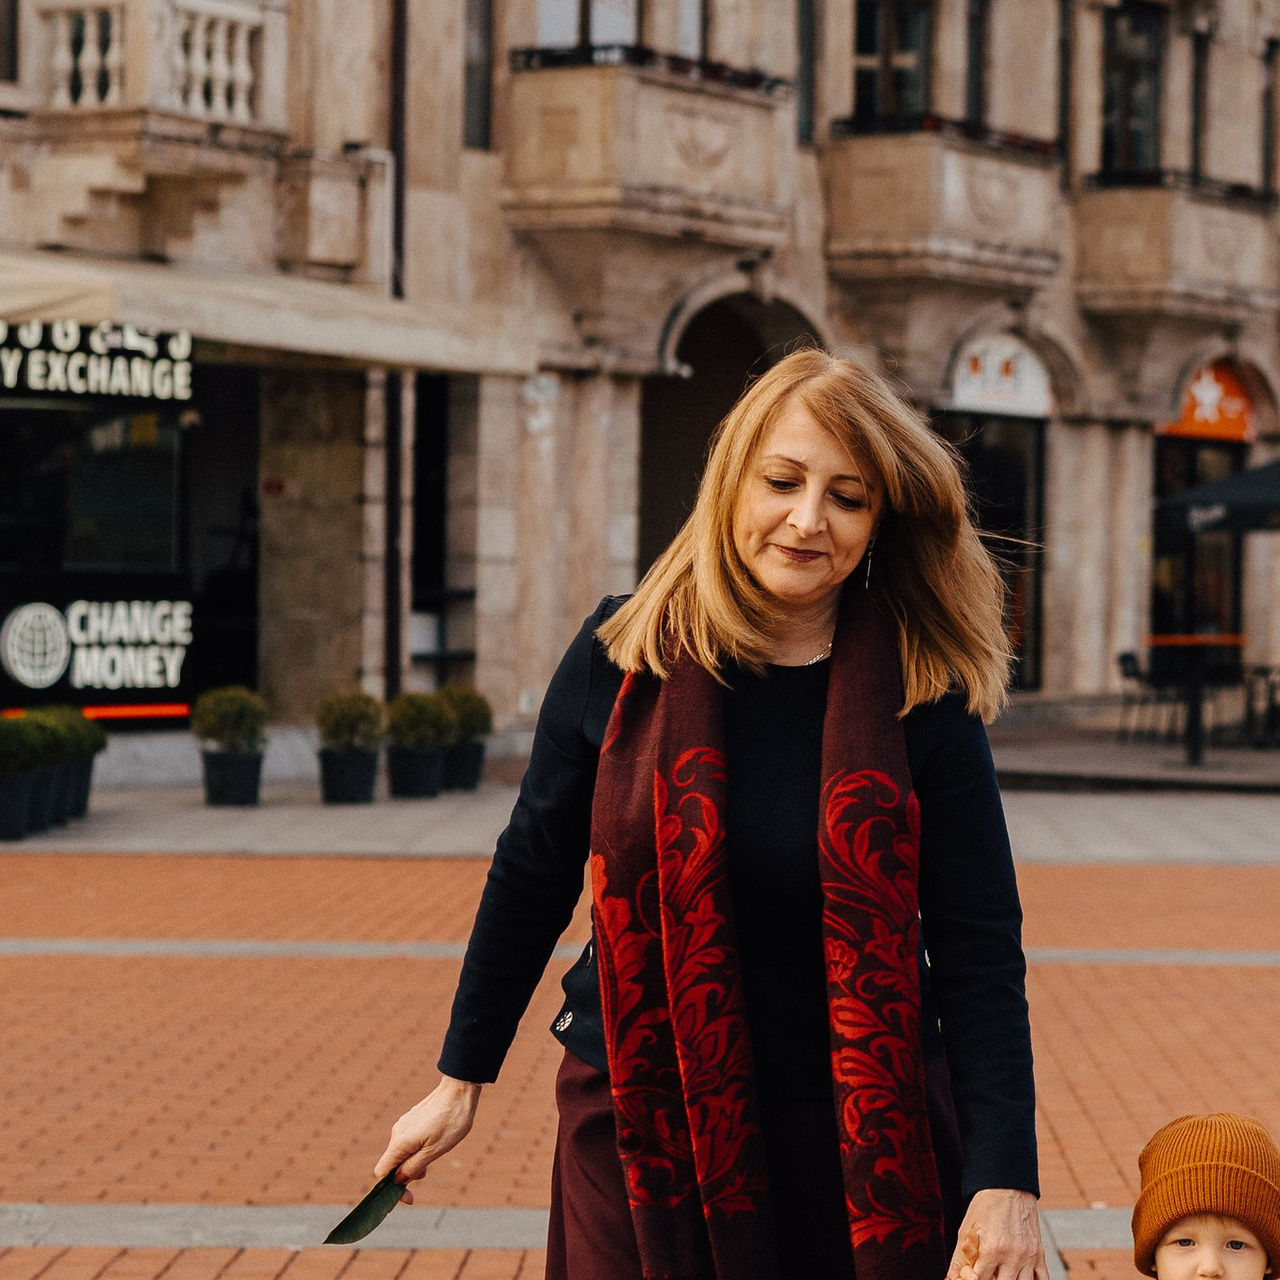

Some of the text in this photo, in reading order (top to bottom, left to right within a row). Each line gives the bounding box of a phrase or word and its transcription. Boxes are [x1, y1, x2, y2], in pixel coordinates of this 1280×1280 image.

[27, 349, 192, 400] EXCHANGE
[68, 600, 193, 645] CHANGE
[73, 645, 186, 689] MONEY
